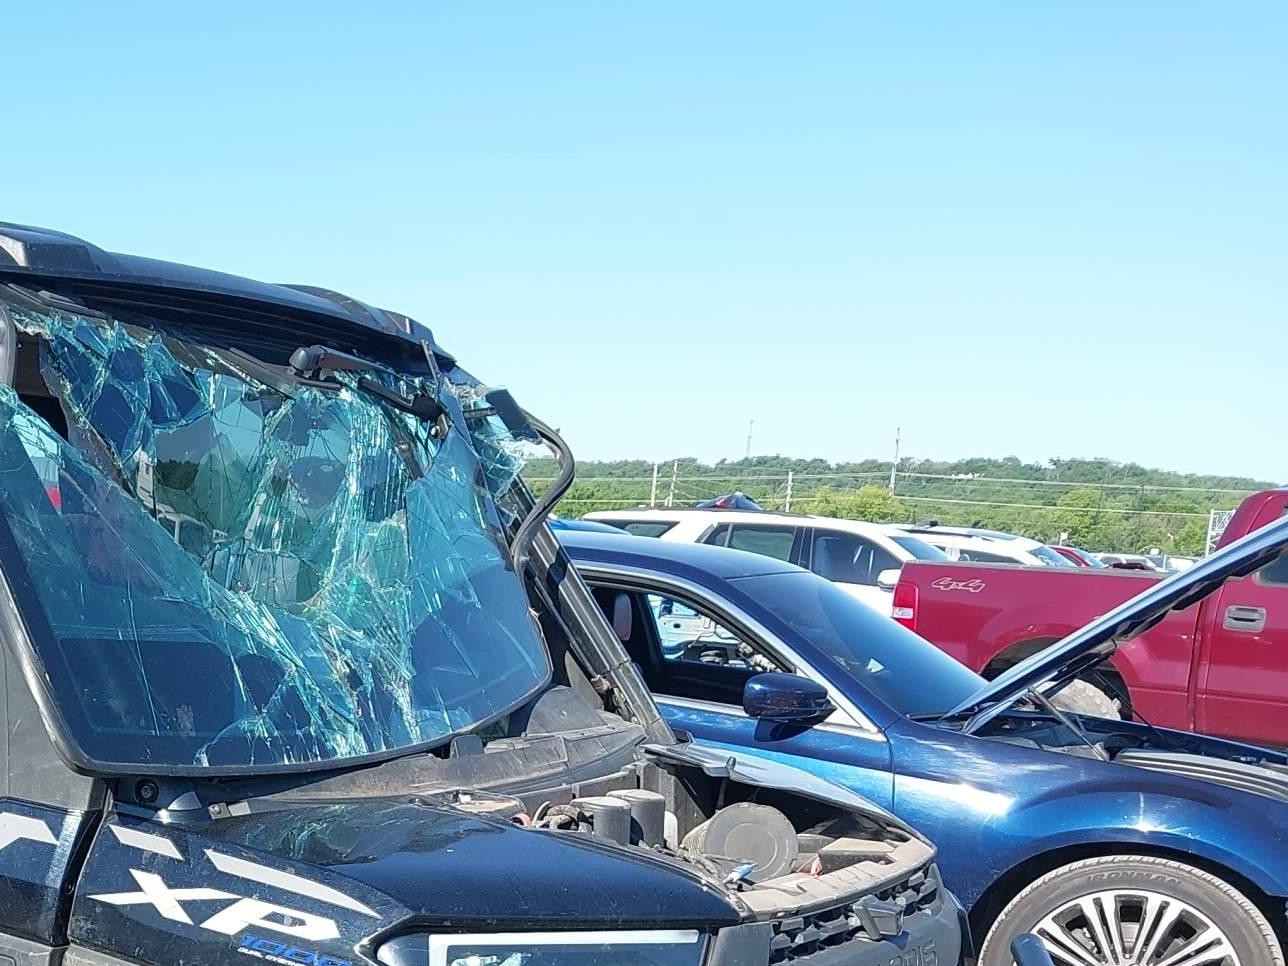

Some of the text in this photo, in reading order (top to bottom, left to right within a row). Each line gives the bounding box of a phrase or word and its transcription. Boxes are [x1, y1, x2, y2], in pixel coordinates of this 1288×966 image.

[931, 577, 986, 593] 4x4
[1087, 870, 1186, 887] IRONMAN
[86, 868, 342, 942] XP
